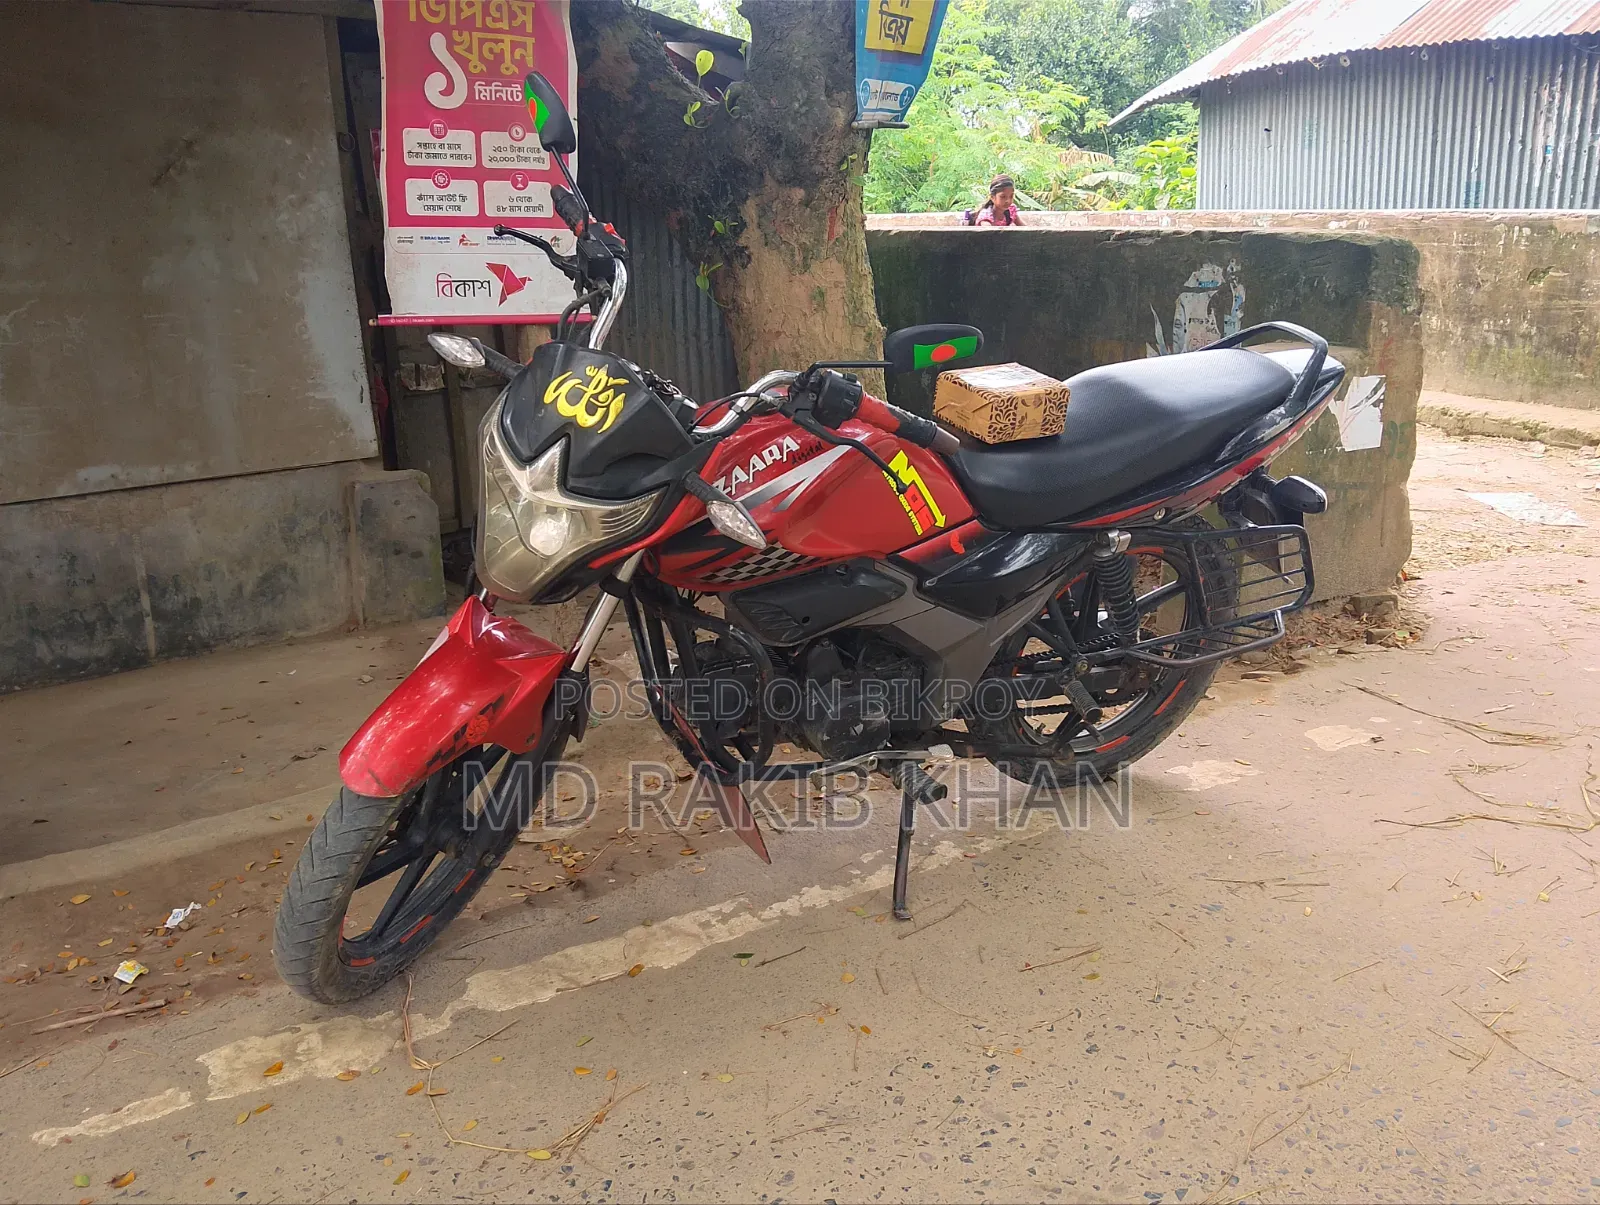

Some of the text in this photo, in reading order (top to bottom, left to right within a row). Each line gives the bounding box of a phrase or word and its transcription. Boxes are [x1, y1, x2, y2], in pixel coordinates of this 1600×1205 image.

[452, 29, 536, 76] খুলুন
[423, 31, 468, 110] ১
[473, 81, 523, 103] মিনিটে
[446, 143, 462, 151] মাসে
[492, 145, 508, 153] ২৫০
[509, 144, 525, 153] টাকা
[407, 150, 423, 159] টাকা
[435, 194, 457, 202] আউট
[496, 205, 507, 213] ৪৮
[508, 205, 522, 213] মাস
[436, 272, 492, 298] বিকাশ
